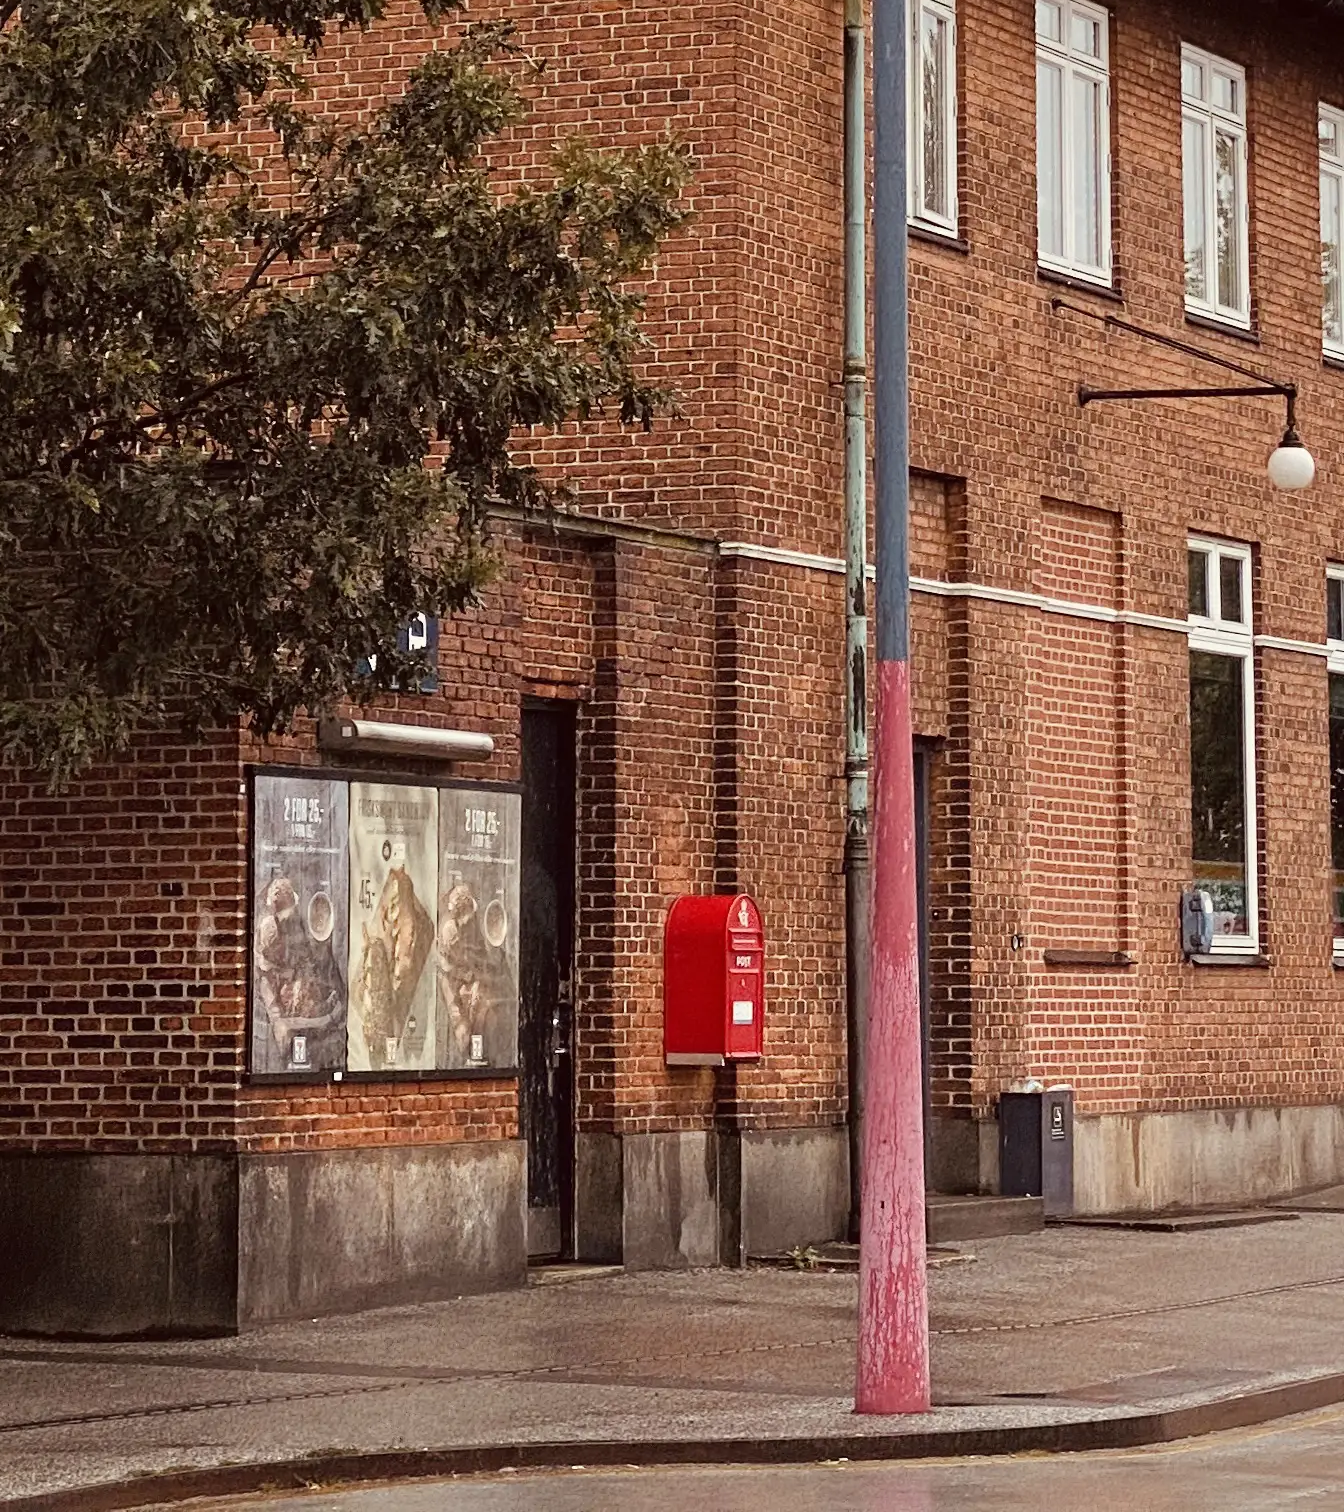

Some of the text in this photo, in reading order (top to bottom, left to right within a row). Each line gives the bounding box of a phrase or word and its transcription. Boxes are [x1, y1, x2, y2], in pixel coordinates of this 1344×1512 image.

[284, 797, 290, 821] 2
[292, 798, 307, 821] FOR
[465, 808, 471, 831] 2
[471, 809, 486, 833] FOR
